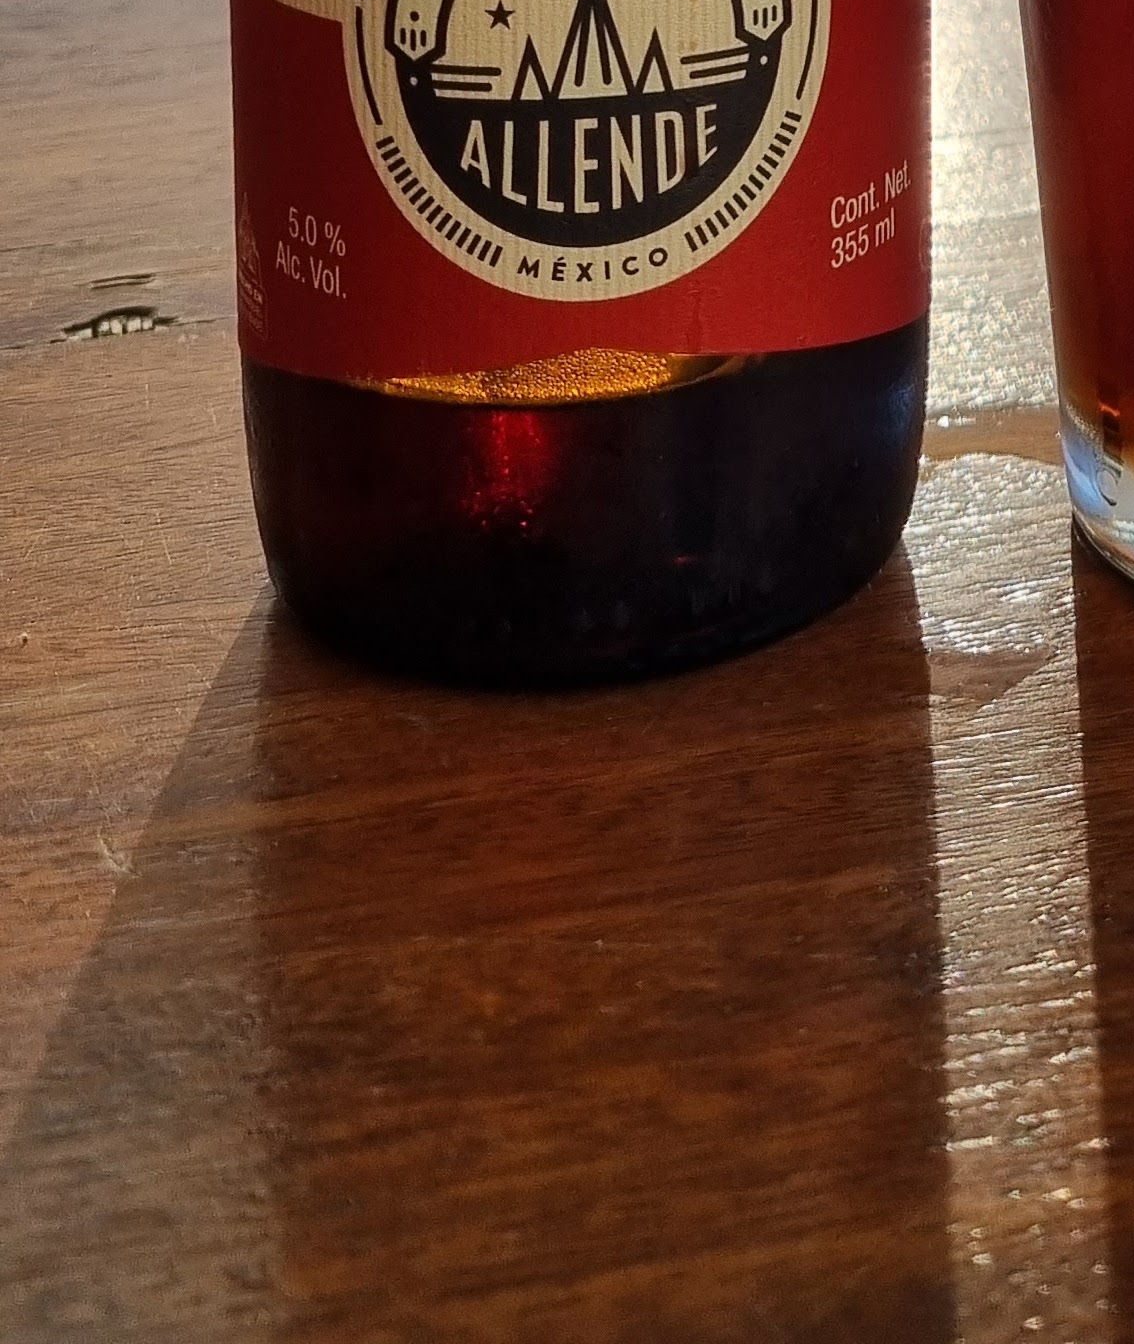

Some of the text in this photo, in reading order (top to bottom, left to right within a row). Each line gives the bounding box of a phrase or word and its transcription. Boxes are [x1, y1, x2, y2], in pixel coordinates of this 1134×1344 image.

[460, 103, 719, 214] ALLENDE
[830, 159, 911, 229] Cont. Net.
[288, 206, 347, 257] 5.0 %
[830, 207, 895, 269] 355 ml
[276, 240, 306, 284] Alc.
[310, 256, 347, 299] Vol.
[517, 246, 670, 283] MÉXICO
